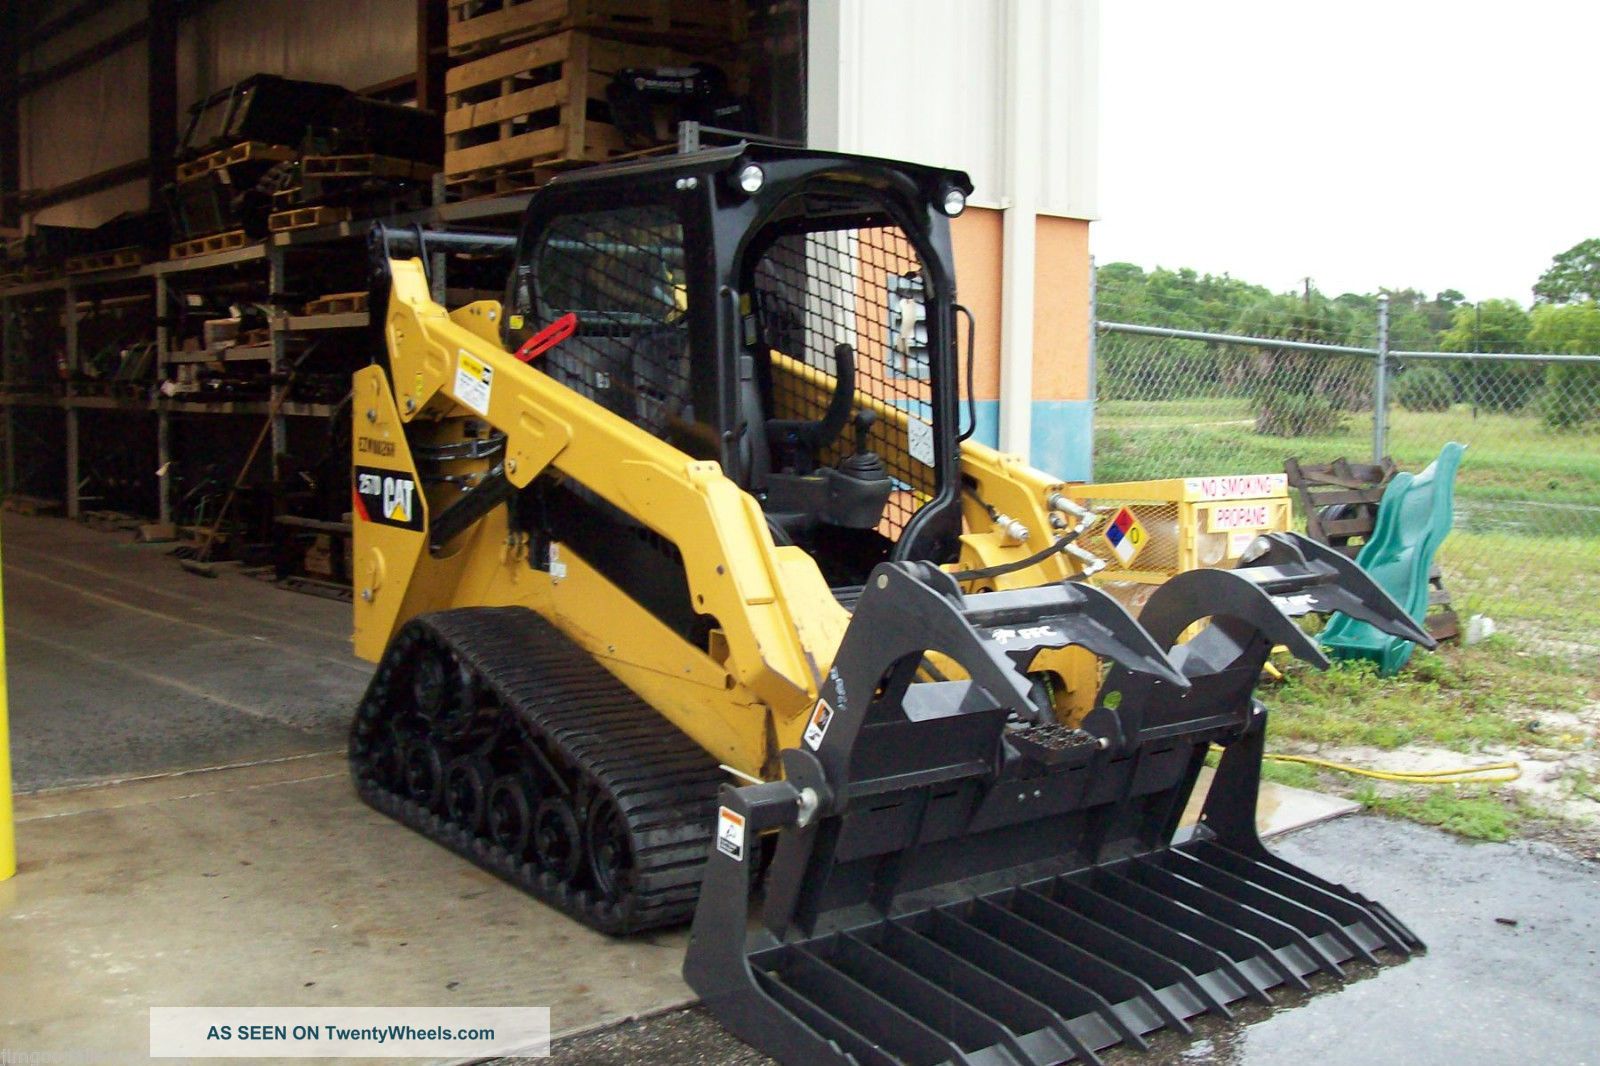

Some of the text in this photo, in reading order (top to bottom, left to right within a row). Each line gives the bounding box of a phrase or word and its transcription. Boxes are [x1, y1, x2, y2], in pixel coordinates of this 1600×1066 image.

[1202, 476, 1271, 497] NO SMOKING
[383, 476, 415, 522] CAT
[1217, 506, 1267, 527] PROPANE
